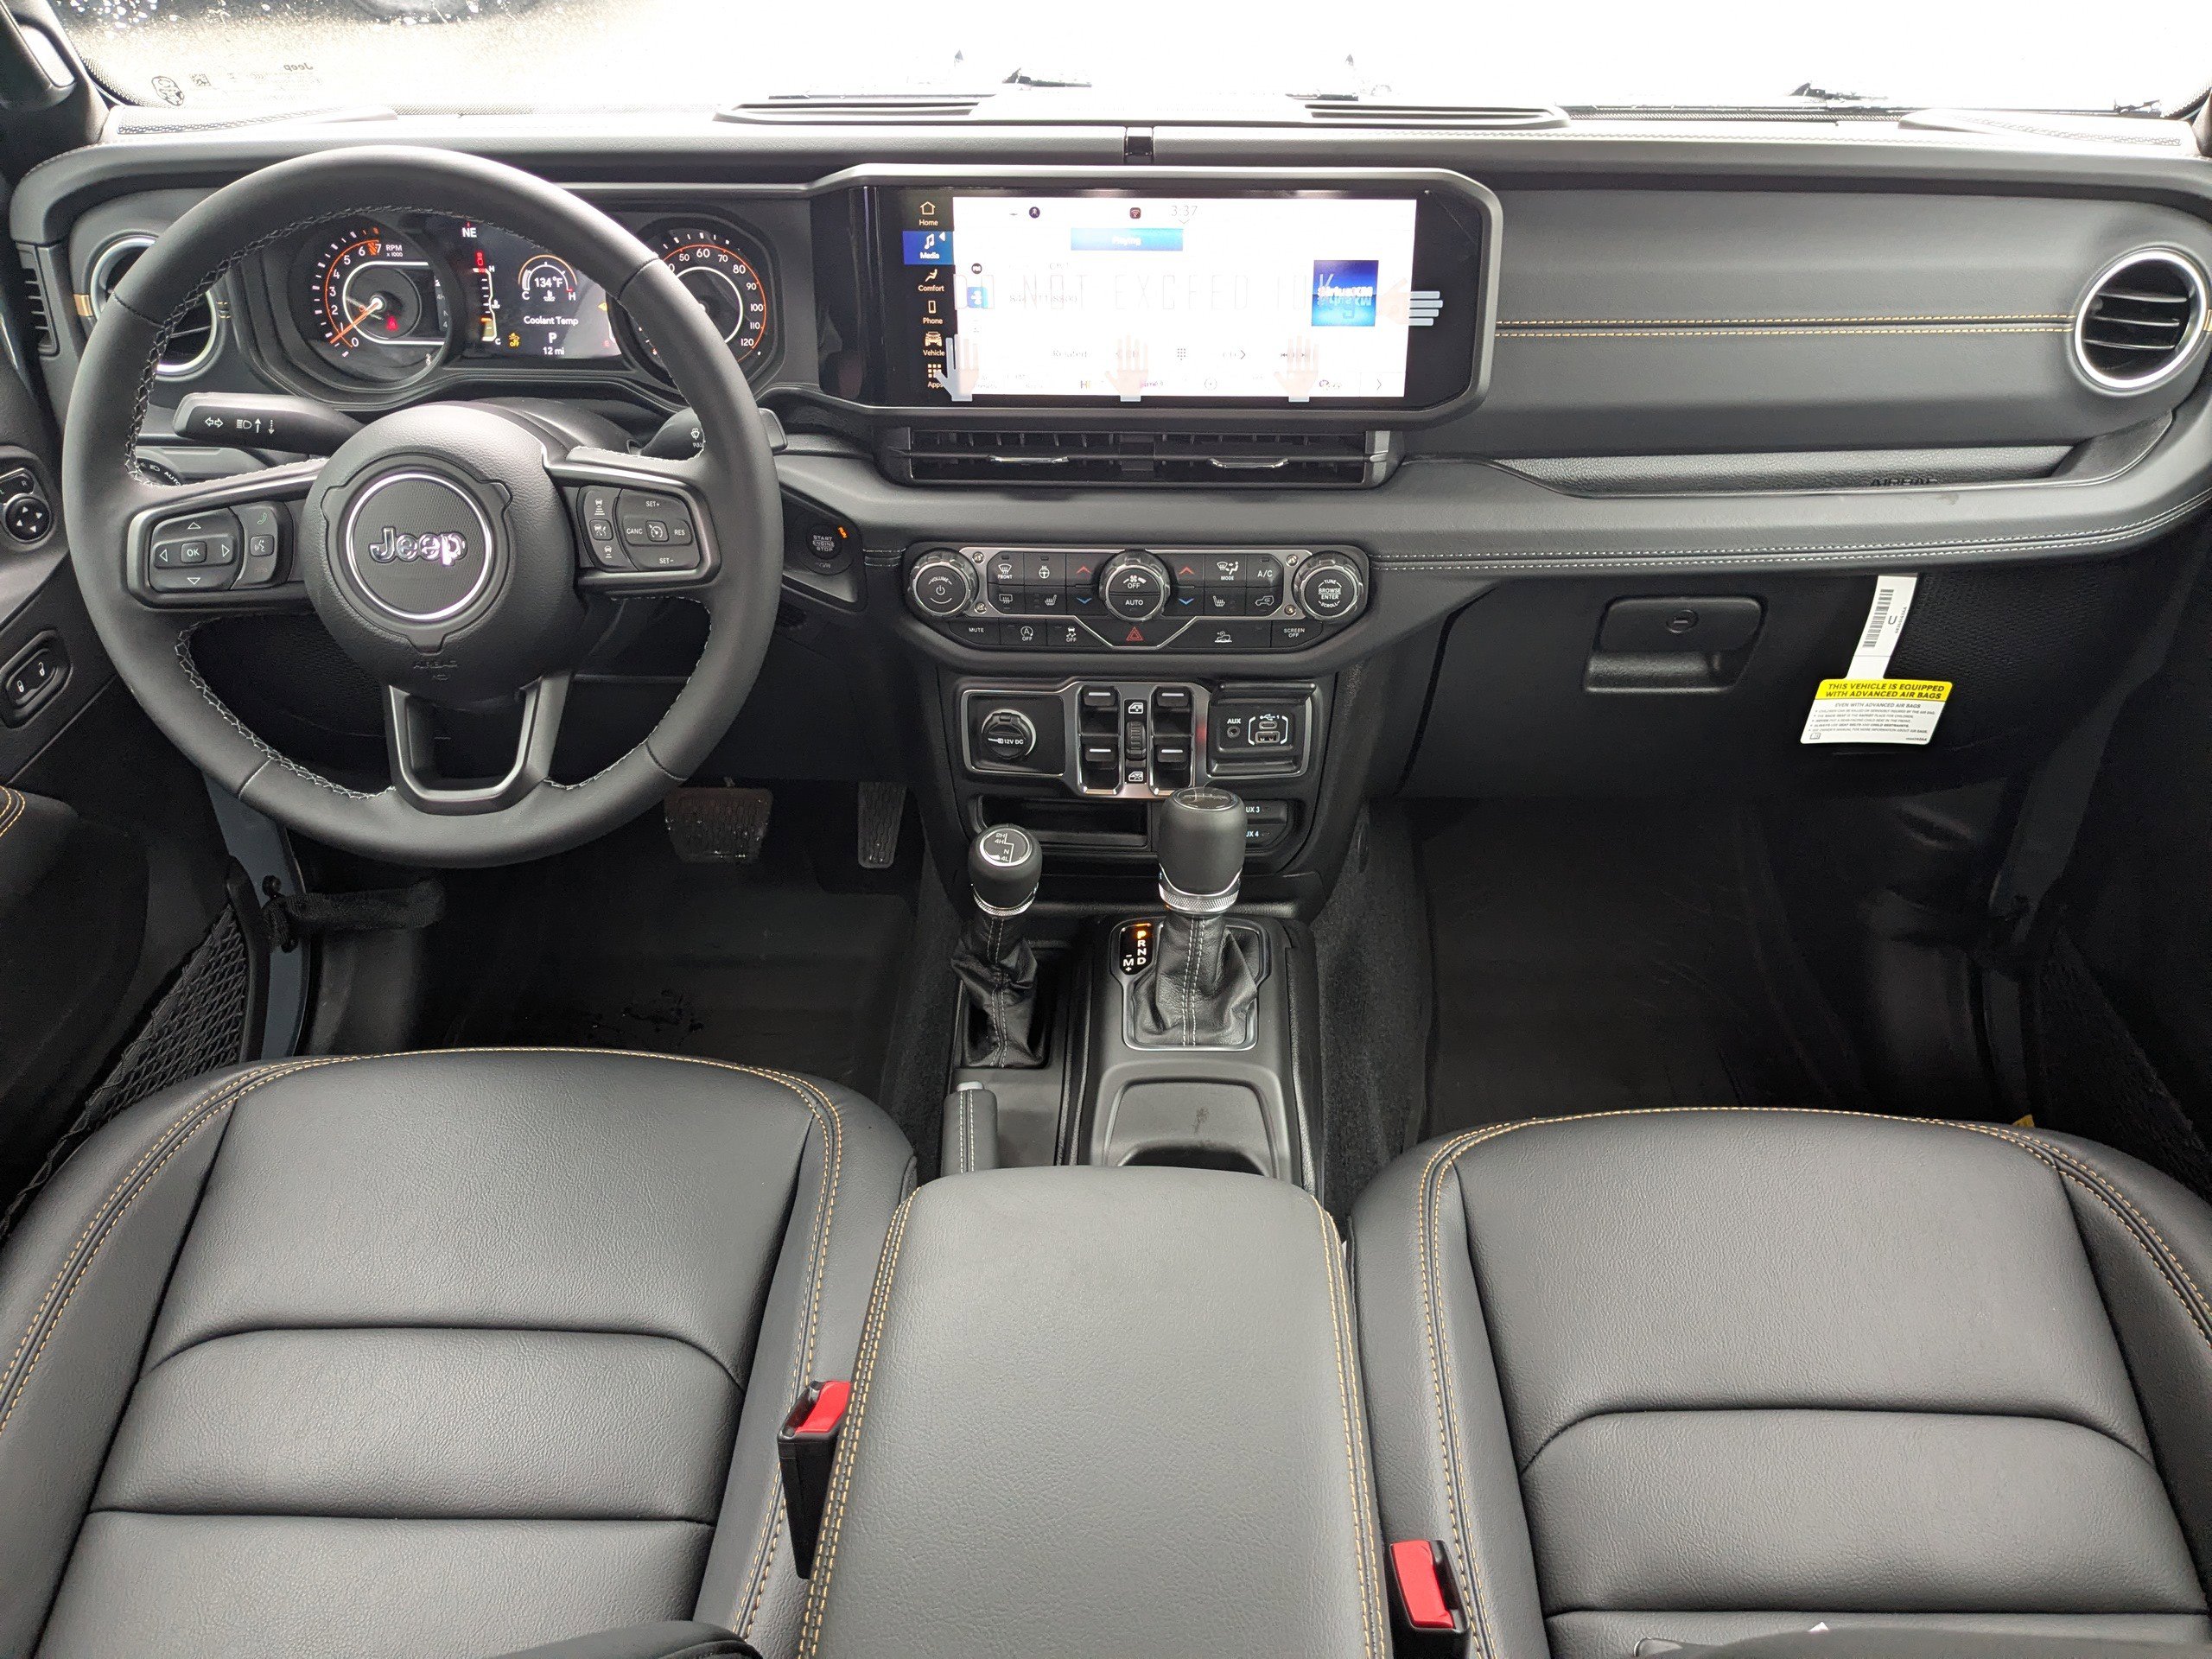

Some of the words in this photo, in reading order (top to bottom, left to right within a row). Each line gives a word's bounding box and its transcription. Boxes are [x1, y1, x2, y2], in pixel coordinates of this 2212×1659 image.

[461, 227, 477, 238] NE
[359, 246, 365, 257] 6
[696, 249, 710, 258] 60
[344, 255, 351, 265] 5
[733, 264, 746, 274] 80
[333, 270, 340, 279] 4
[329, 287, 337, 297] 3
[522, 291, 531, 301] C
[569, 292, 576, 301] H
[332, 305, 339, 315] 2
[750, 303, 764, 312] 100
[524, 316, 555, 325] Coolant
[556, 316, 579, 327] Temp
[352, 337, 359, 346] 0
[548, 333, 556, 344] P
[741, 338, 754, 346] 120
[543, 346, 553, 355] 12
[554, 346, 565, 355] mi
[164, 471, 181, 486] AUTO
[368, 525, 467, 567] Jeep
[187, 548, 200, 556] OK
[1137, 930, 1147, 939] P
